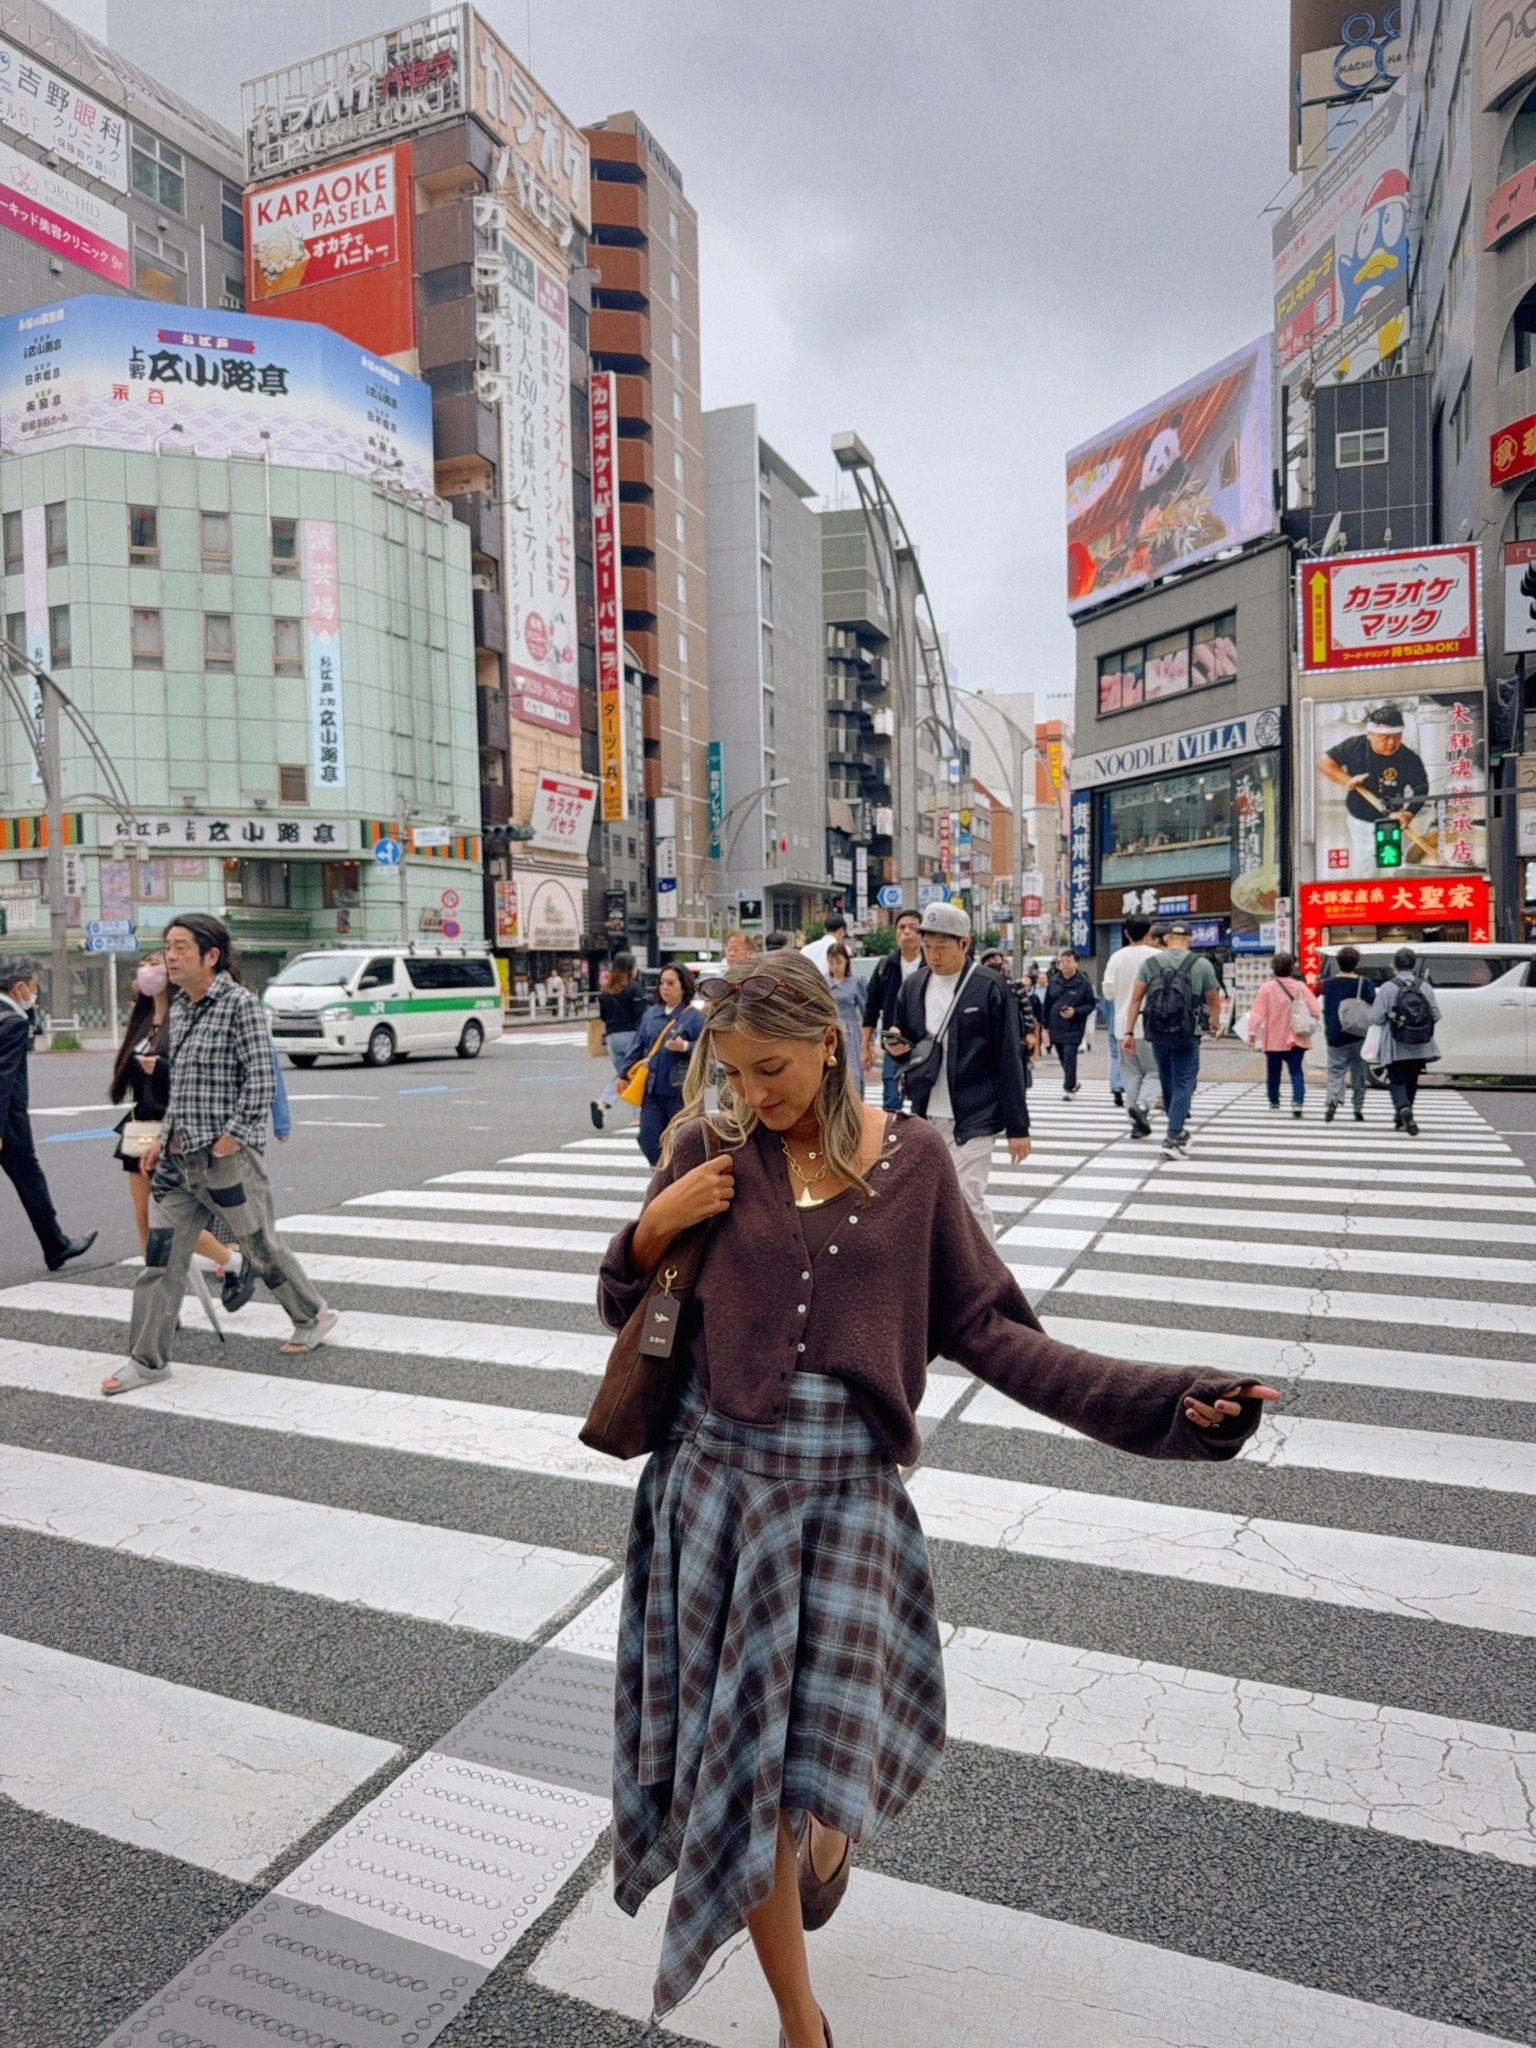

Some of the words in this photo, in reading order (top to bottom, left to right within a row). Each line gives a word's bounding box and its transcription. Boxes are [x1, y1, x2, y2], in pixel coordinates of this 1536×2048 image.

[380, 47, 455, 100] パセラ
[18, 63, 122, 148] 吉野眼科
[478, 36, 586, 208] カラオケ
[52, 114, 121, 162] クリニック
[45, 179, 100, 218] ORCHID
[256, 162, 388, 227] KARAOKE
[311, 194, 388, 232] PASELA
[494, 145, 576, 250] パセラ
[312, 232, 365, 258] オカチで
[474, 198, 510, 402] カラオケ
[182, 333, 229, 349] お江戸
[129, 345, 146, 381] 上野
[310, 529, 336, 621] 演芸場
[1343, 577, 1457, 611] カラオケ
[599, 599, 618, 670] パセラ
[1360, 608, 1440, 638] マック
[1391, 640, 1460, 658] 持ち込みOK!
[1094, 740, 1174, 780] NOODLE
[1178, 725, 1246, 760] VILLA
[1446, 702, 1474, 864] 大輝魂継承店
[546, 795, 584, 818] カラオケ
[547, 815, 577, 836] パセラ
[116, 823, 171, 837] お江戸
[1390, 884, 1475, 910] 大聖家
[1303, 926, 1319, 970] ライス
[370, 1001, 385, 1014] JR
